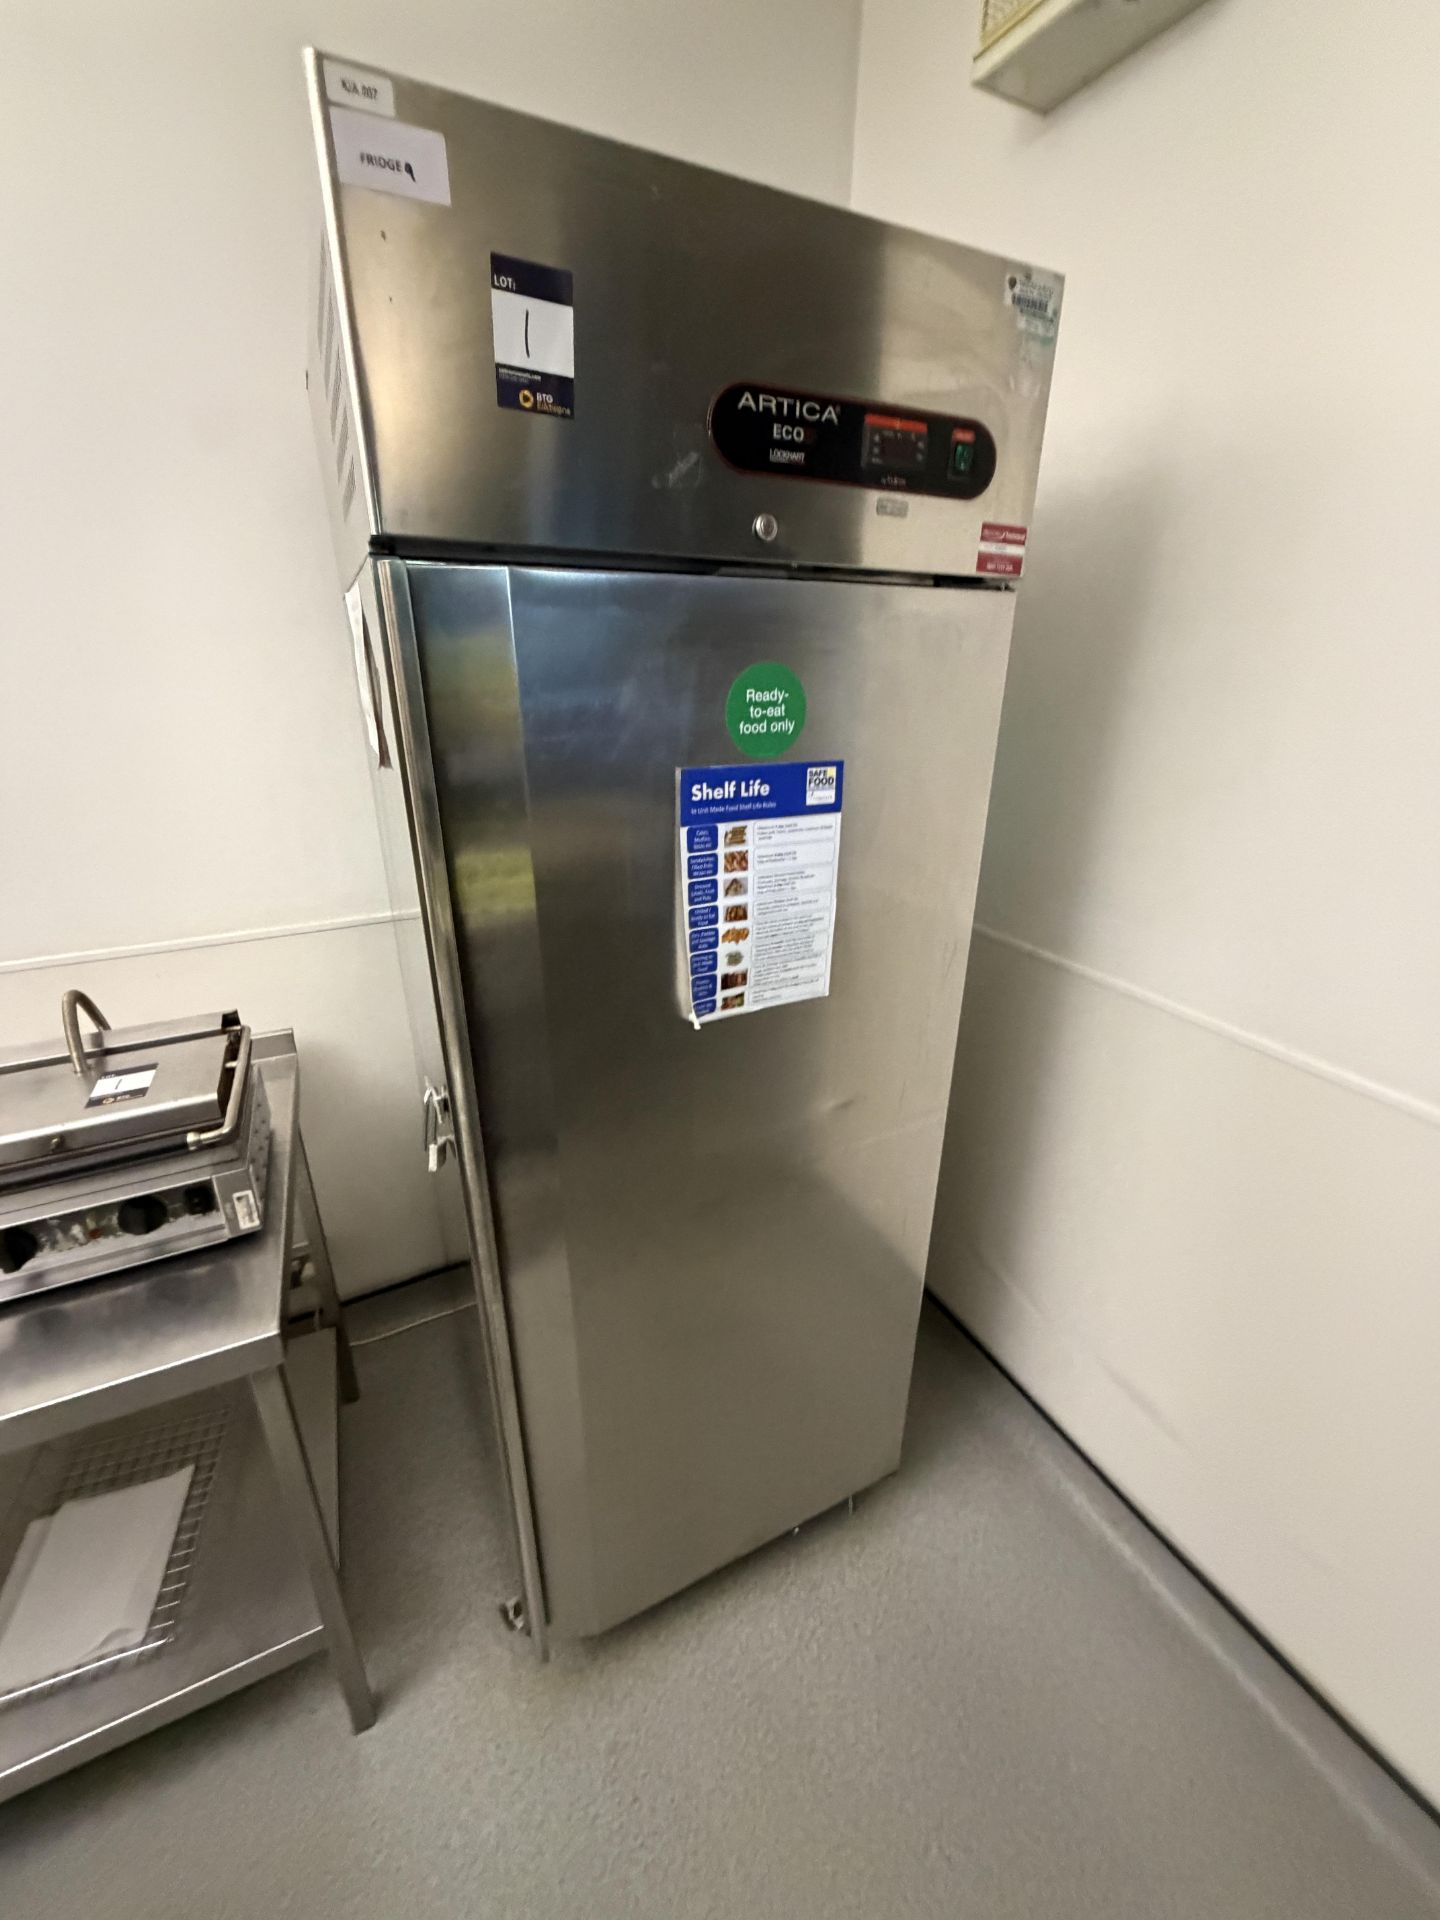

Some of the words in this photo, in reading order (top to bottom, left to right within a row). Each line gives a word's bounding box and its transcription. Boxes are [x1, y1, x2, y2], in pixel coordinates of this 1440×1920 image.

[360, 152, 402, 173] FRIDGE
[737, 391, 839, 425] ARTICA
[773, 422, 805, 443] ECO
[746, 687, 789, 704] Ready-
[750, 703, 786, 719] to-eat
[739, 718, 767, 735] food
[770, 717, 796, 735] only
[691, 780, 736, 801] Shelf
[740, 779, 771, 797] Life
[808, 776, 835, 787] FOOD
[725, 804, 739, 812] Food
